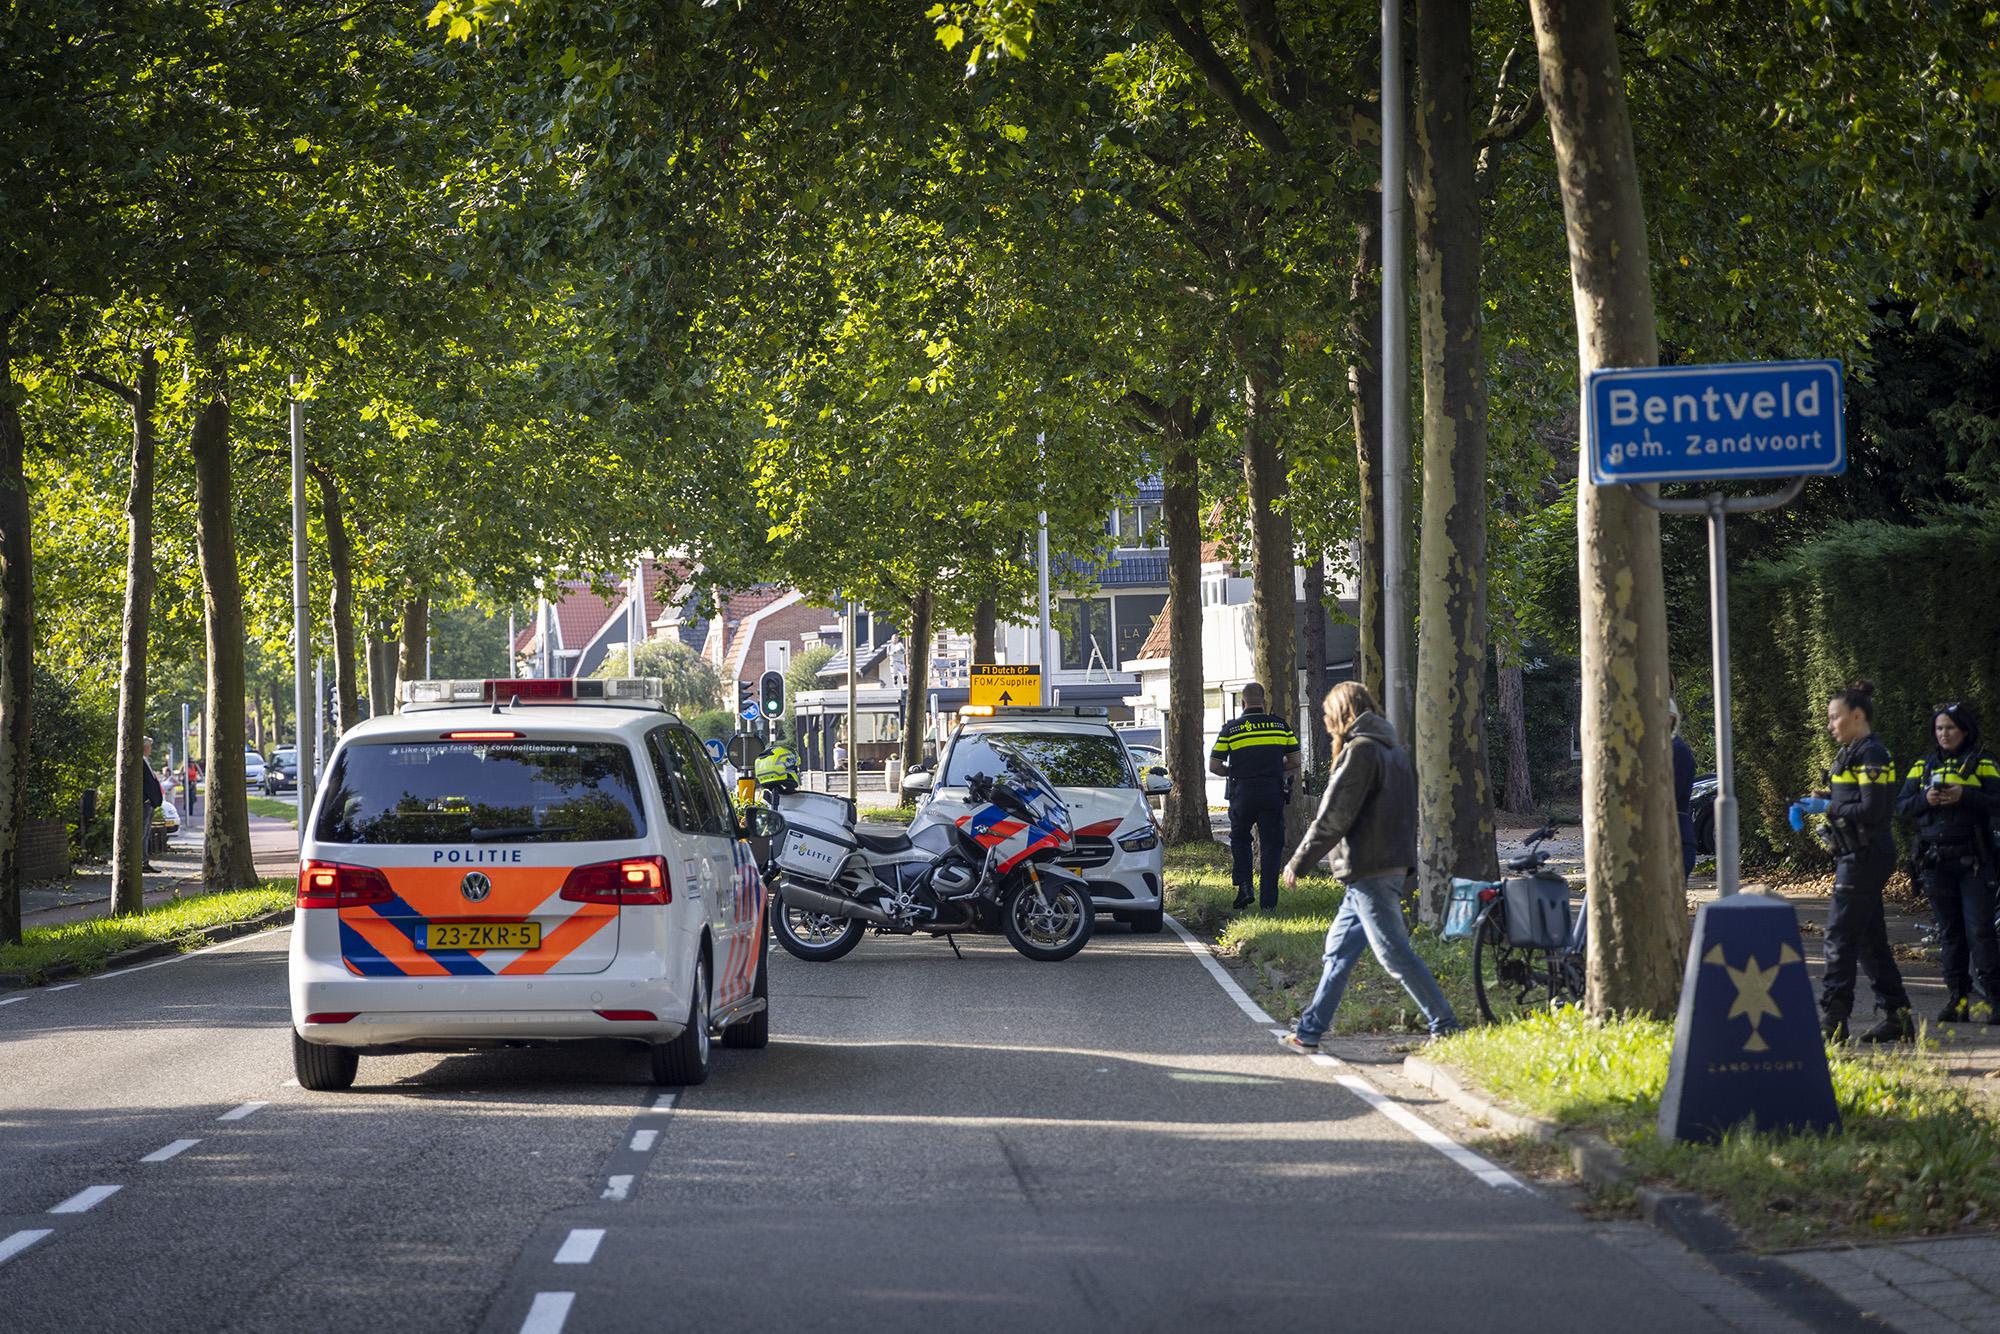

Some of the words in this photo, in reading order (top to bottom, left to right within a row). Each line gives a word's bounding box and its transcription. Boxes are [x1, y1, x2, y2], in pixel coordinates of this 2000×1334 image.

[1609, 380, 1820, 426] Bentveld
[1609, 440, 1672, 465] gem.
[1686, 430, 1822, 455] Zandvoort
[1124, 628, 1140, 639] LA
[992, 666, 1015, 674] Dutch
[1017, 666, 1029, 674] GP
[974, 677, 1037, 687] FOM/Supplier
[433, 850, 522, 863] POLITIE
[791, 843, 833, 863] POLITIE
[416, 938, 425, 946] NL
[436, 927, 531, 945] 23-ZKR-5
